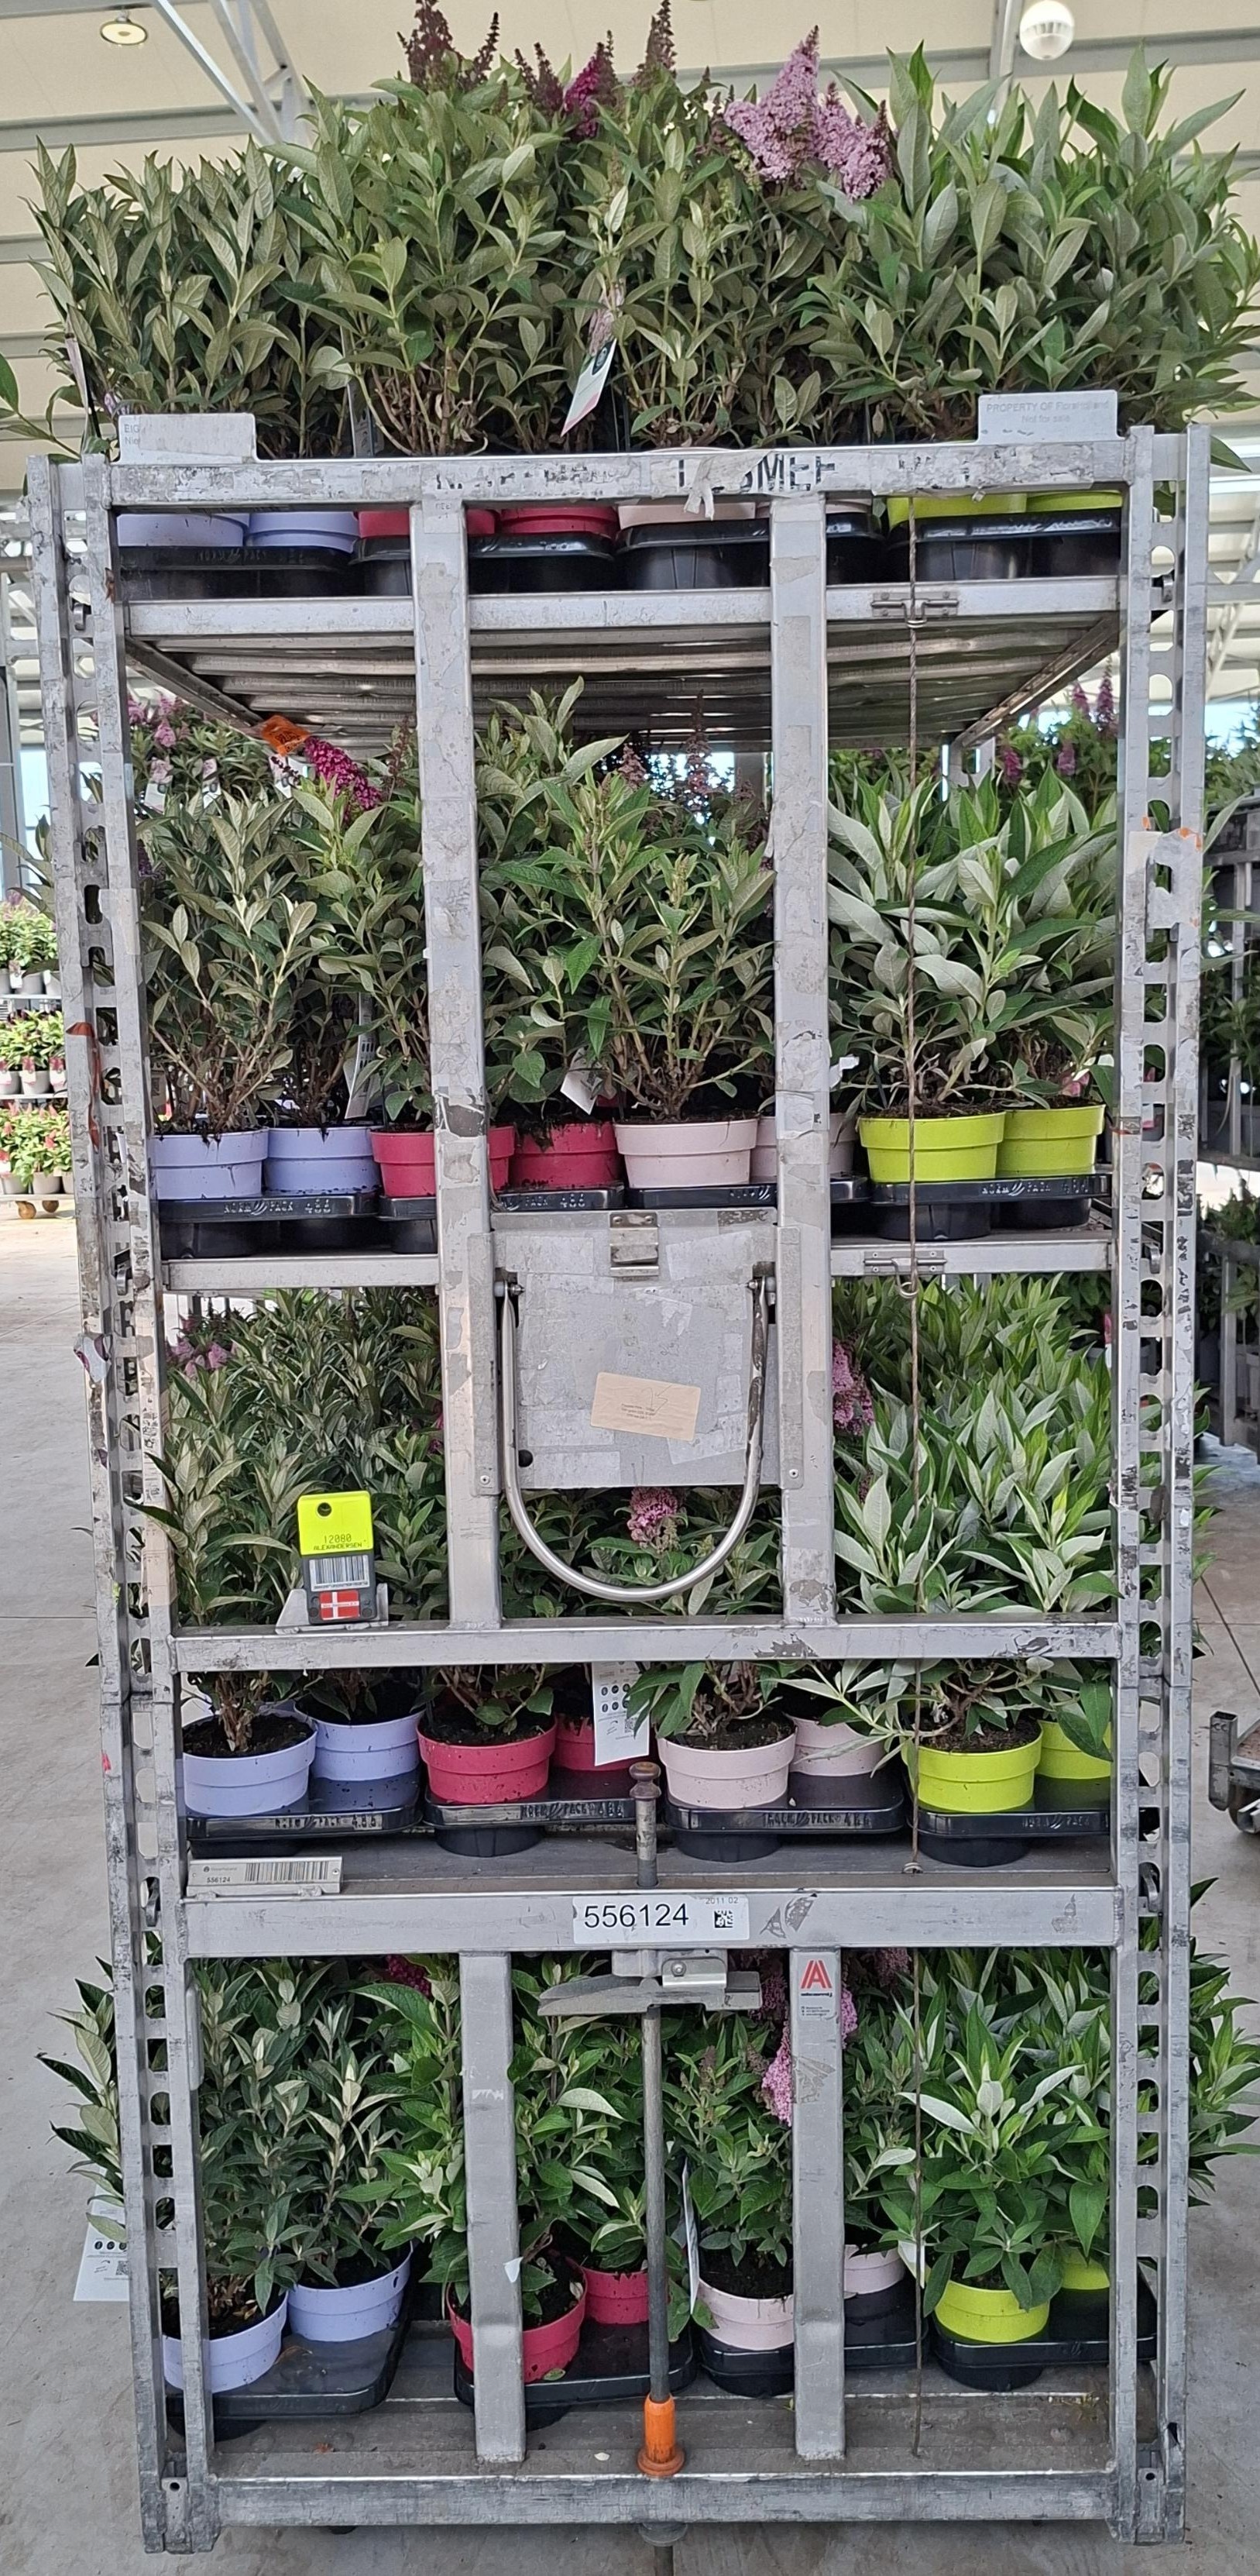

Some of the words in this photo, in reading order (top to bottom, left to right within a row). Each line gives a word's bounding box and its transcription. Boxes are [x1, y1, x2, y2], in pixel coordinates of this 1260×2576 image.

[986, 402, 1038, 413] PROPERTY
[1039, 401, 1054, 411] OF
[1056, 400, 1109, 411] FloraHoland
[324, 1533, 352, 1544] 12080
[313, 1542, 362, 1551] ALEXANDERSEN
[583, 1903, 689, 1928] 556124
[706, 1897, 726, 1905] 2011
